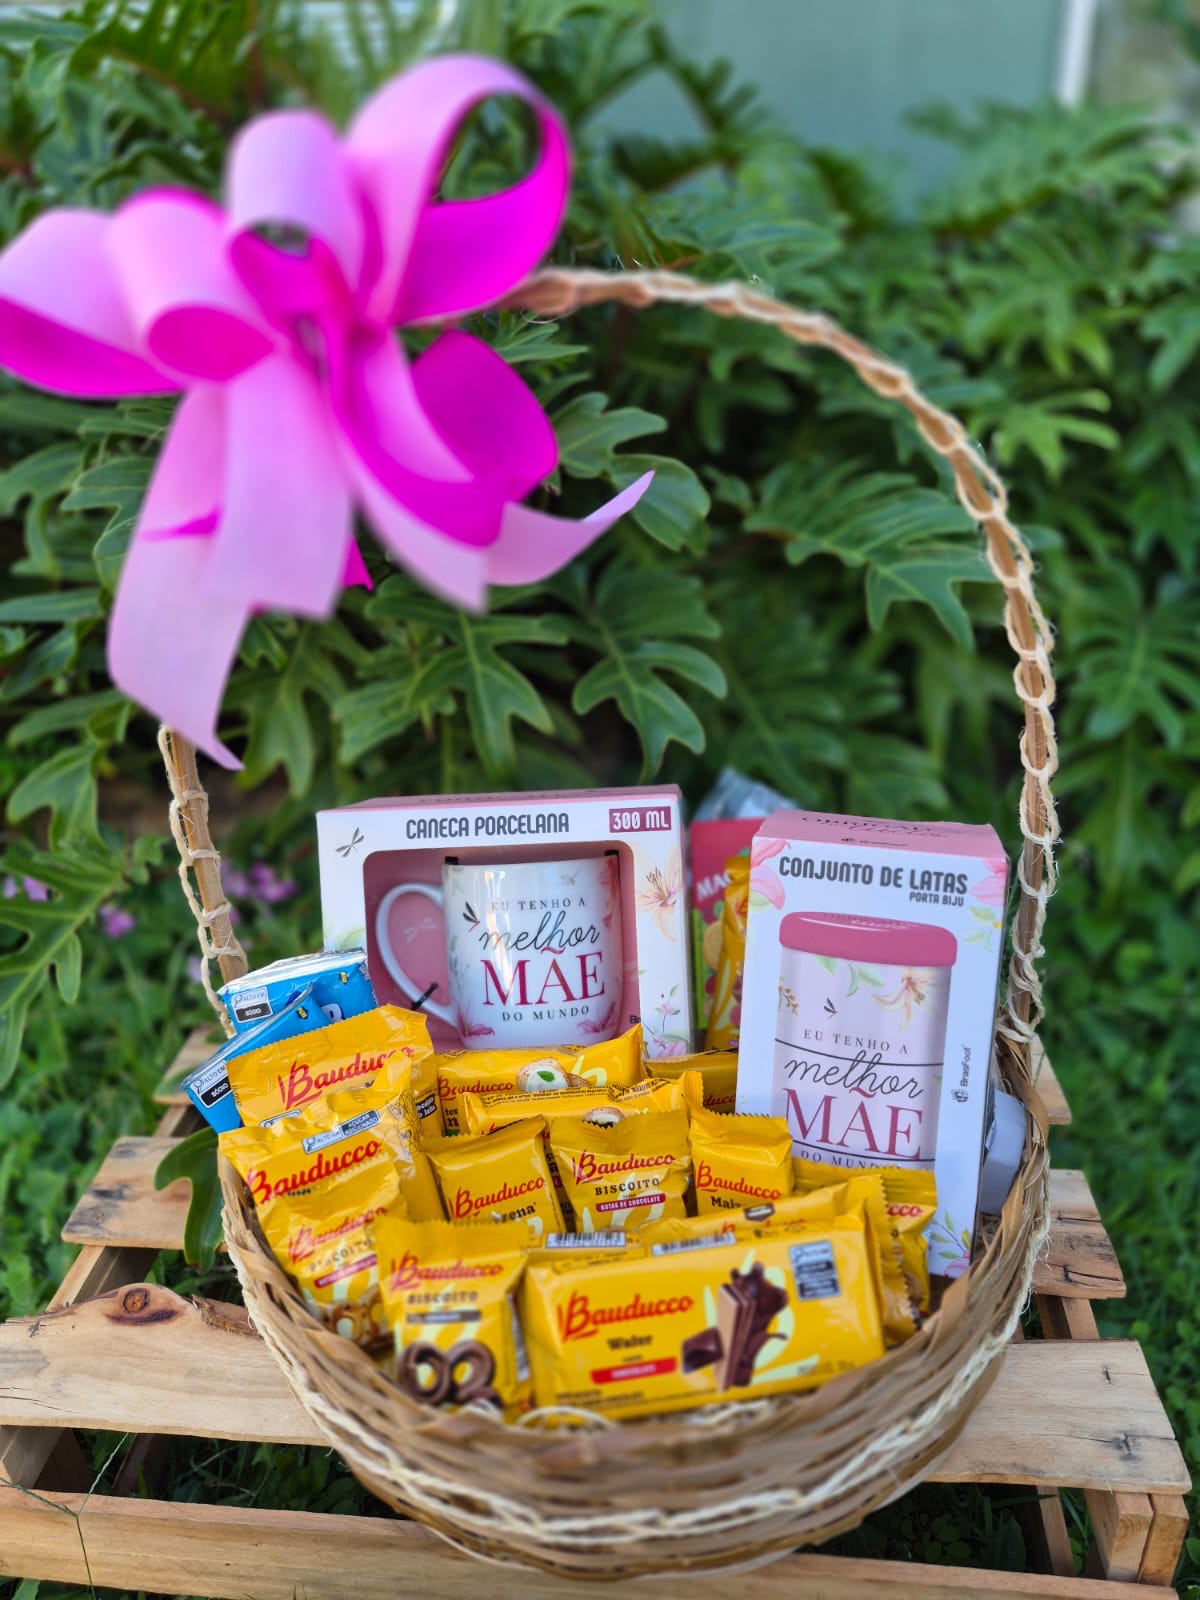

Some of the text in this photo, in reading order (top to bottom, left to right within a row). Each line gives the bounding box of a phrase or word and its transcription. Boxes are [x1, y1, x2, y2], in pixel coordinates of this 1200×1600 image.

[406, 812, 569, 840] CANECA PORCELANA
[612, 809, 669, 831] 300 ML
[779, 855, 968, 896] CONJUNTO DE LATAS
[491, 896, 586, 912] EU TENHO A
[909, 891, 964, 907] PORTA BIJU
[479, 910, 601, 951] melhor
[481, 946, 605, 1006] MÃE
[502, 1005, 590, 1022] DO MUNDO
[804, 1028, 908, 1055] EU TENHO A
[784, 1050, 925, 1099] melhor
[782, 1086, 924, 1161] MÃE
[247, 1139, 382, 1205] Bauducco
[573, 1149, 676, 1185] Bauducco
[801, 1149, 901, 1169] DO MUN
[448, 1177, 544, 1219] Bauducco
[595, 1177, 660, 1196] BISCOITO
[696, 1160, 782, 1201] Bauducco
[629, 1195, 661, 1207] CHOCOLATE
[390, 1249, 503, 1293] Bauducco
[557, 1290, 694, 1344] Bauducco
